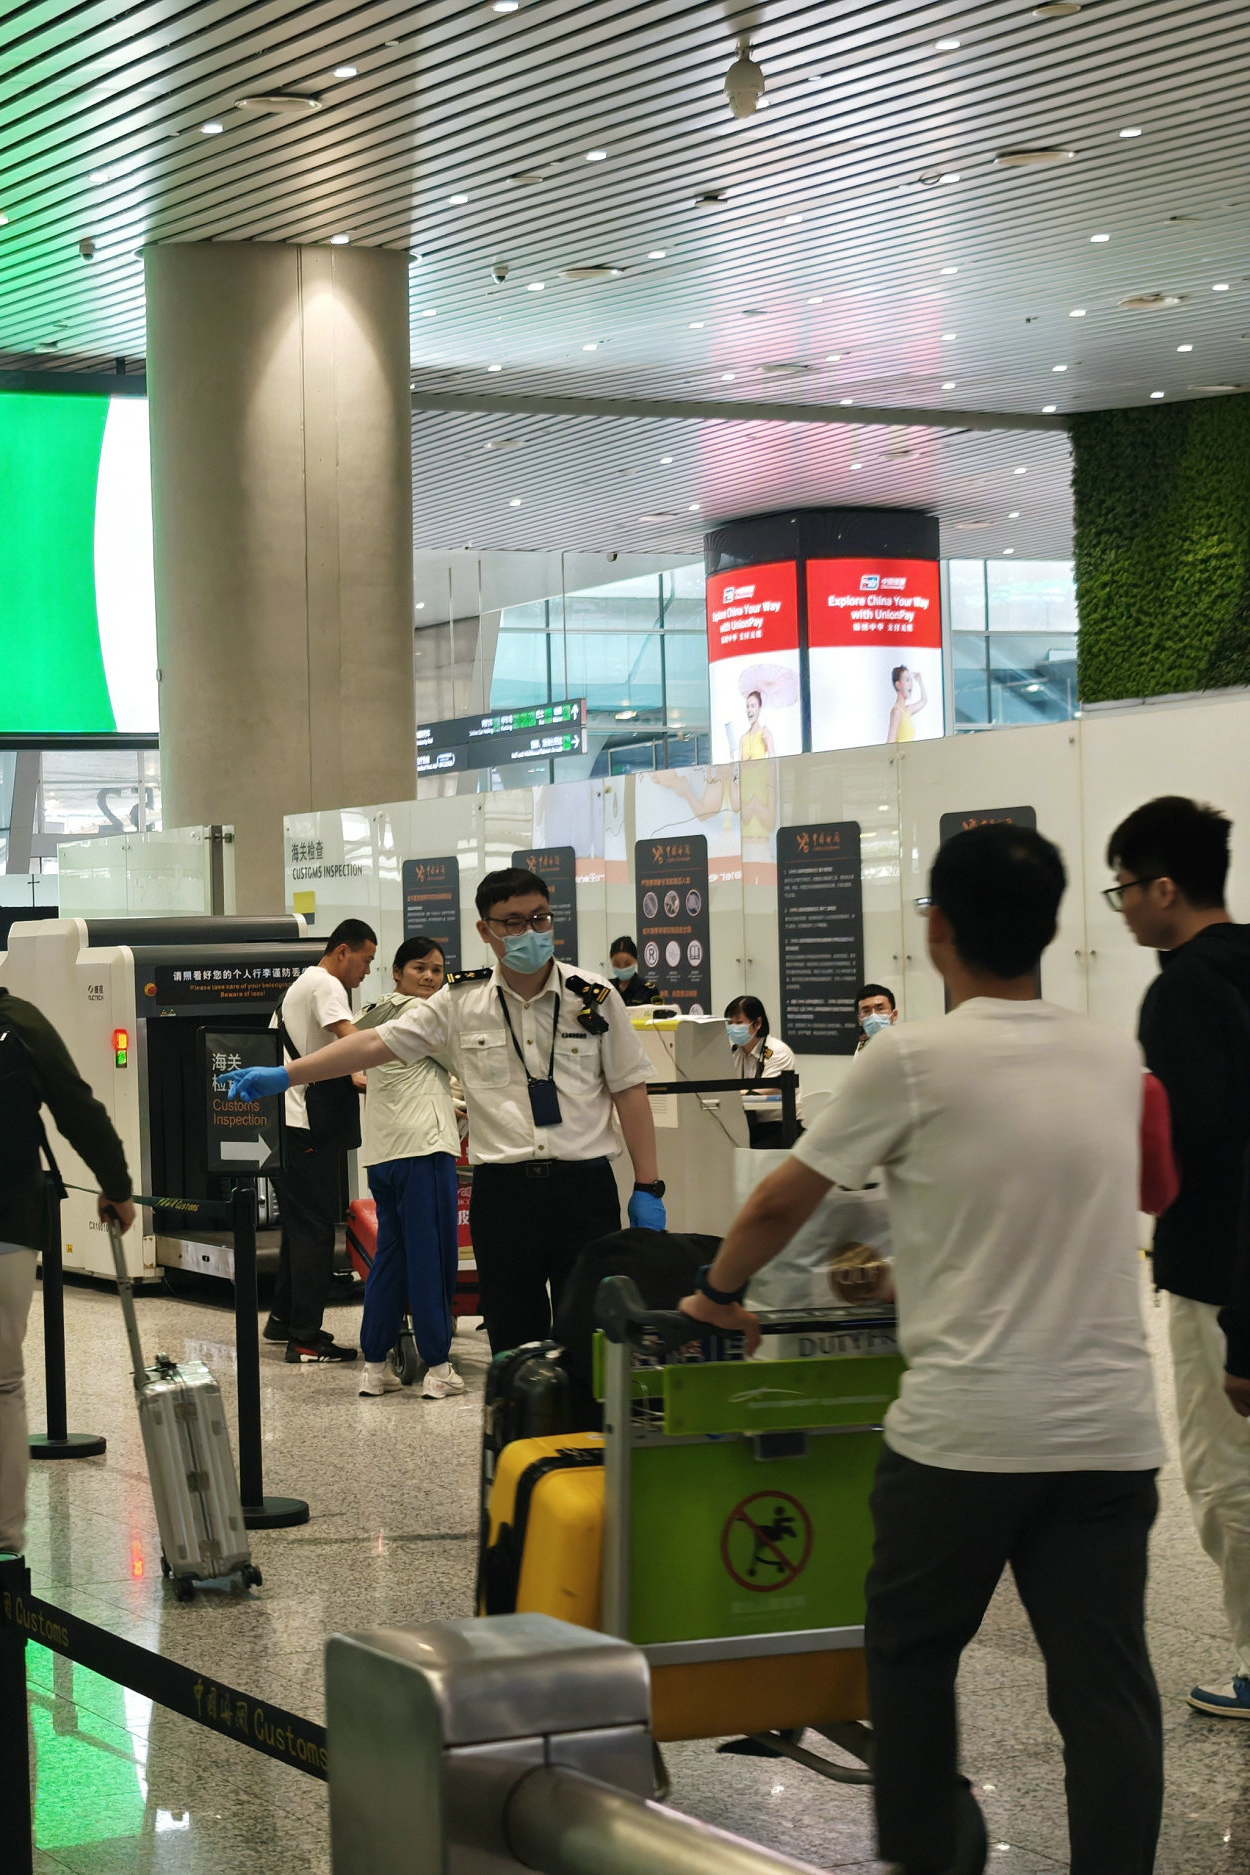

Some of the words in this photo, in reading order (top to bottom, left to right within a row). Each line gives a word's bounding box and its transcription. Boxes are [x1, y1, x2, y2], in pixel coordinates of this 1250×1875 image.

[744, 603, 762, 615] Your
[762, 601, 781, 613] Way
[828, 595, 866, 608] Explore
[867, 595, 892, 606] China
[893, 596, 912, 606] Your
[913, 597, 929, 609] Way
[851, 609, 873, 620] with
[874, 609, 915, 622] UnionPay
[291, 840, 324, 862] 海关检查
[293, 865, 322, 880] CUSTOMS
[324, 864, 363, 878] INSPECTION
[212, 1053, 242, 1072] 海关
[213, 1099, 260, 1112] Customs
[213, 1113, 268, 1128] Inspection
[15, 1597, 69, 1648] Customs
[254, 1708, 328, 1771] Customs
